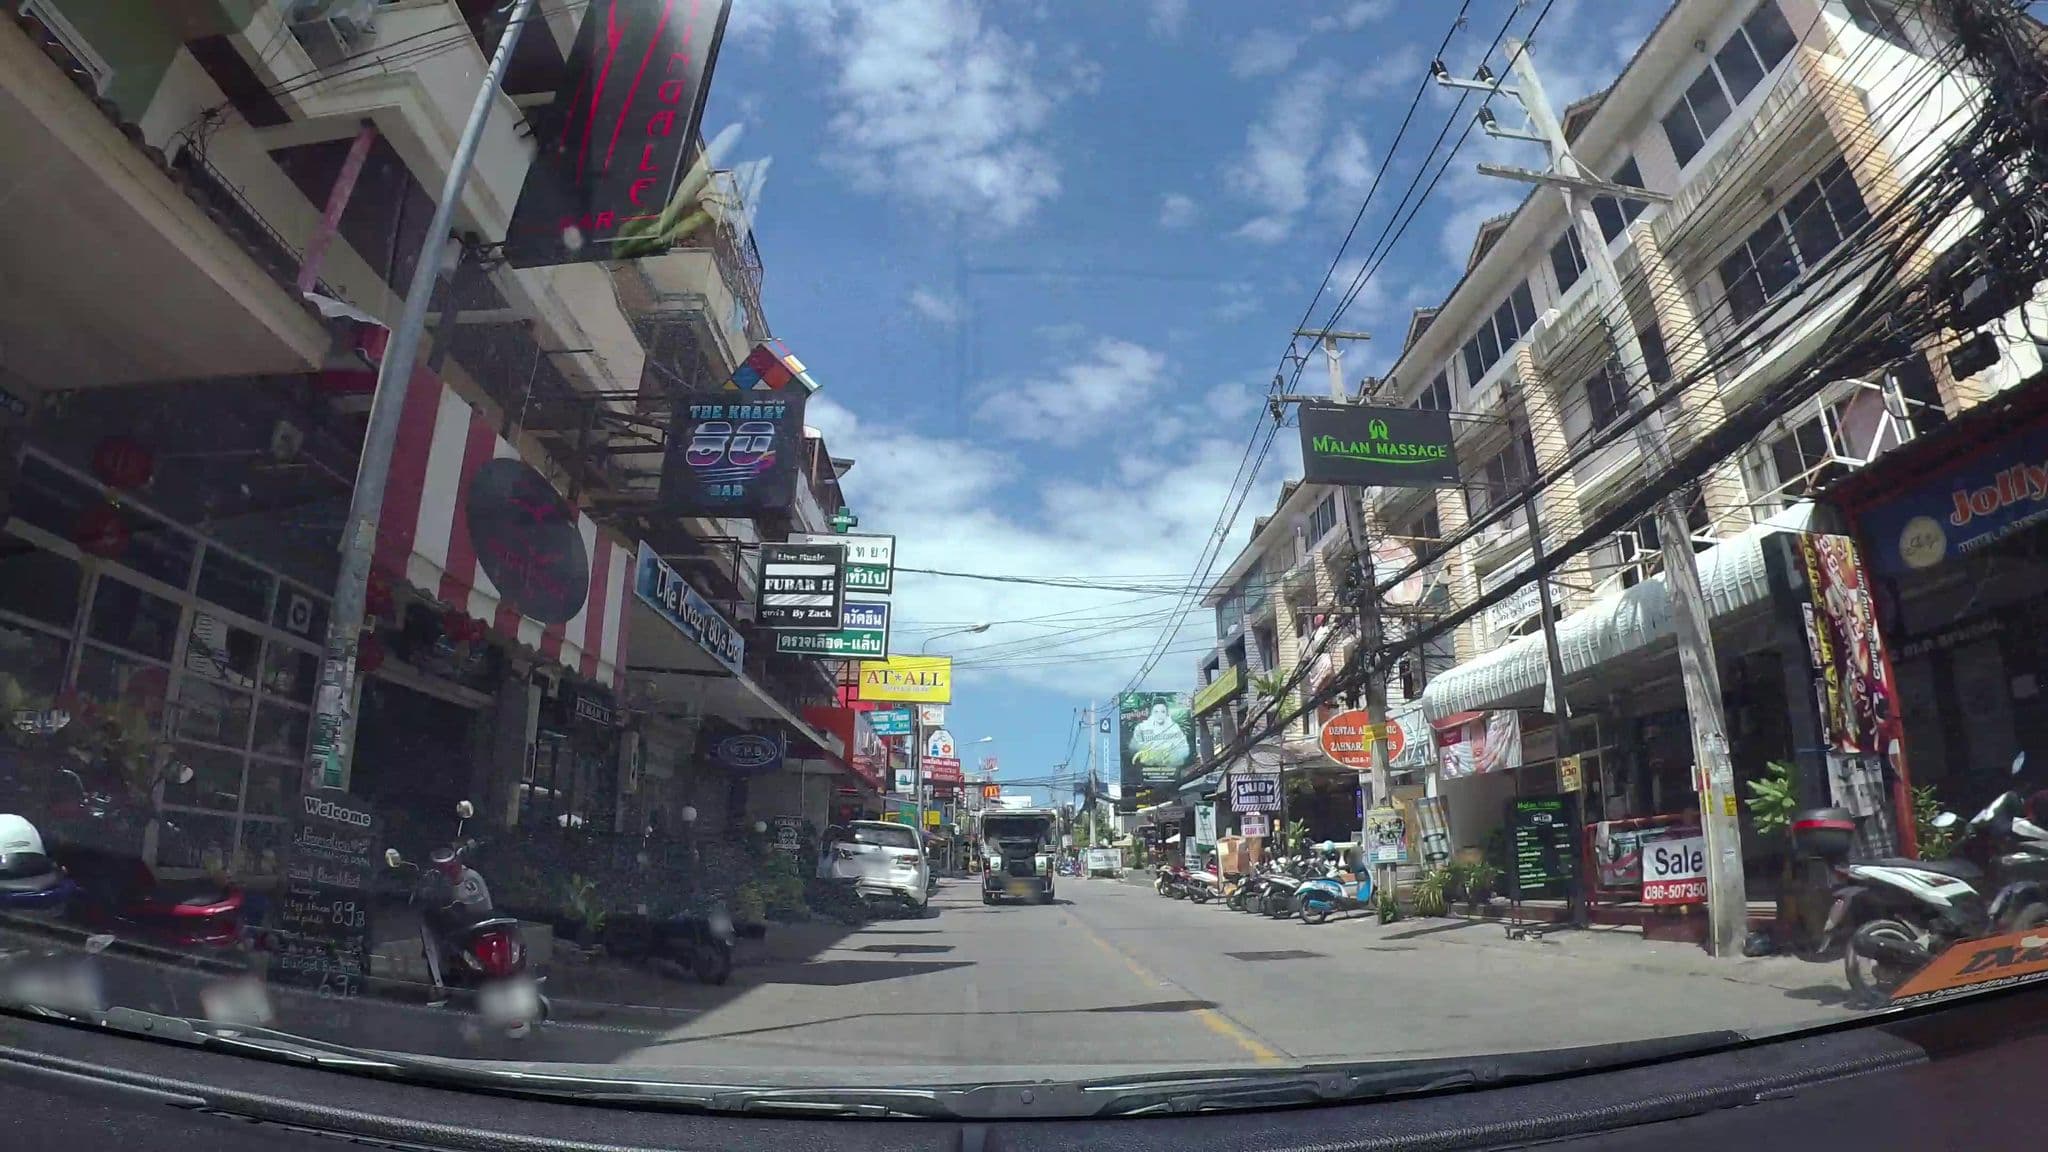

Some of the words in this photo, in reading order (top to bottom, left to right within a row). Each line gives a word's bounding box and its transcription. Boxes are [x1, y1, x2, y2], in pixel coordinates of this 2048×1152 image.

[689, 405, 723, 419] THE
[727, 405, 786, 419] KRAZY
[685, 421, 776, 467] 80
[1376, 442, 1448, 458] MASSAGE
[764, 578, 816, 591] FUBAR
[656, 559, 676, 610] The
[679, 584, 707, 643] Krazy
[792, 609, 806, 619] By
[808, 609, 832, 618] Zack
[1328, 726, 1356, 735] DENTAL
[1238, 782, 1273, 795] ENJOY
[304, 796, 371, 827] Welcome
[1655, 844, 1703, 875] Sale
